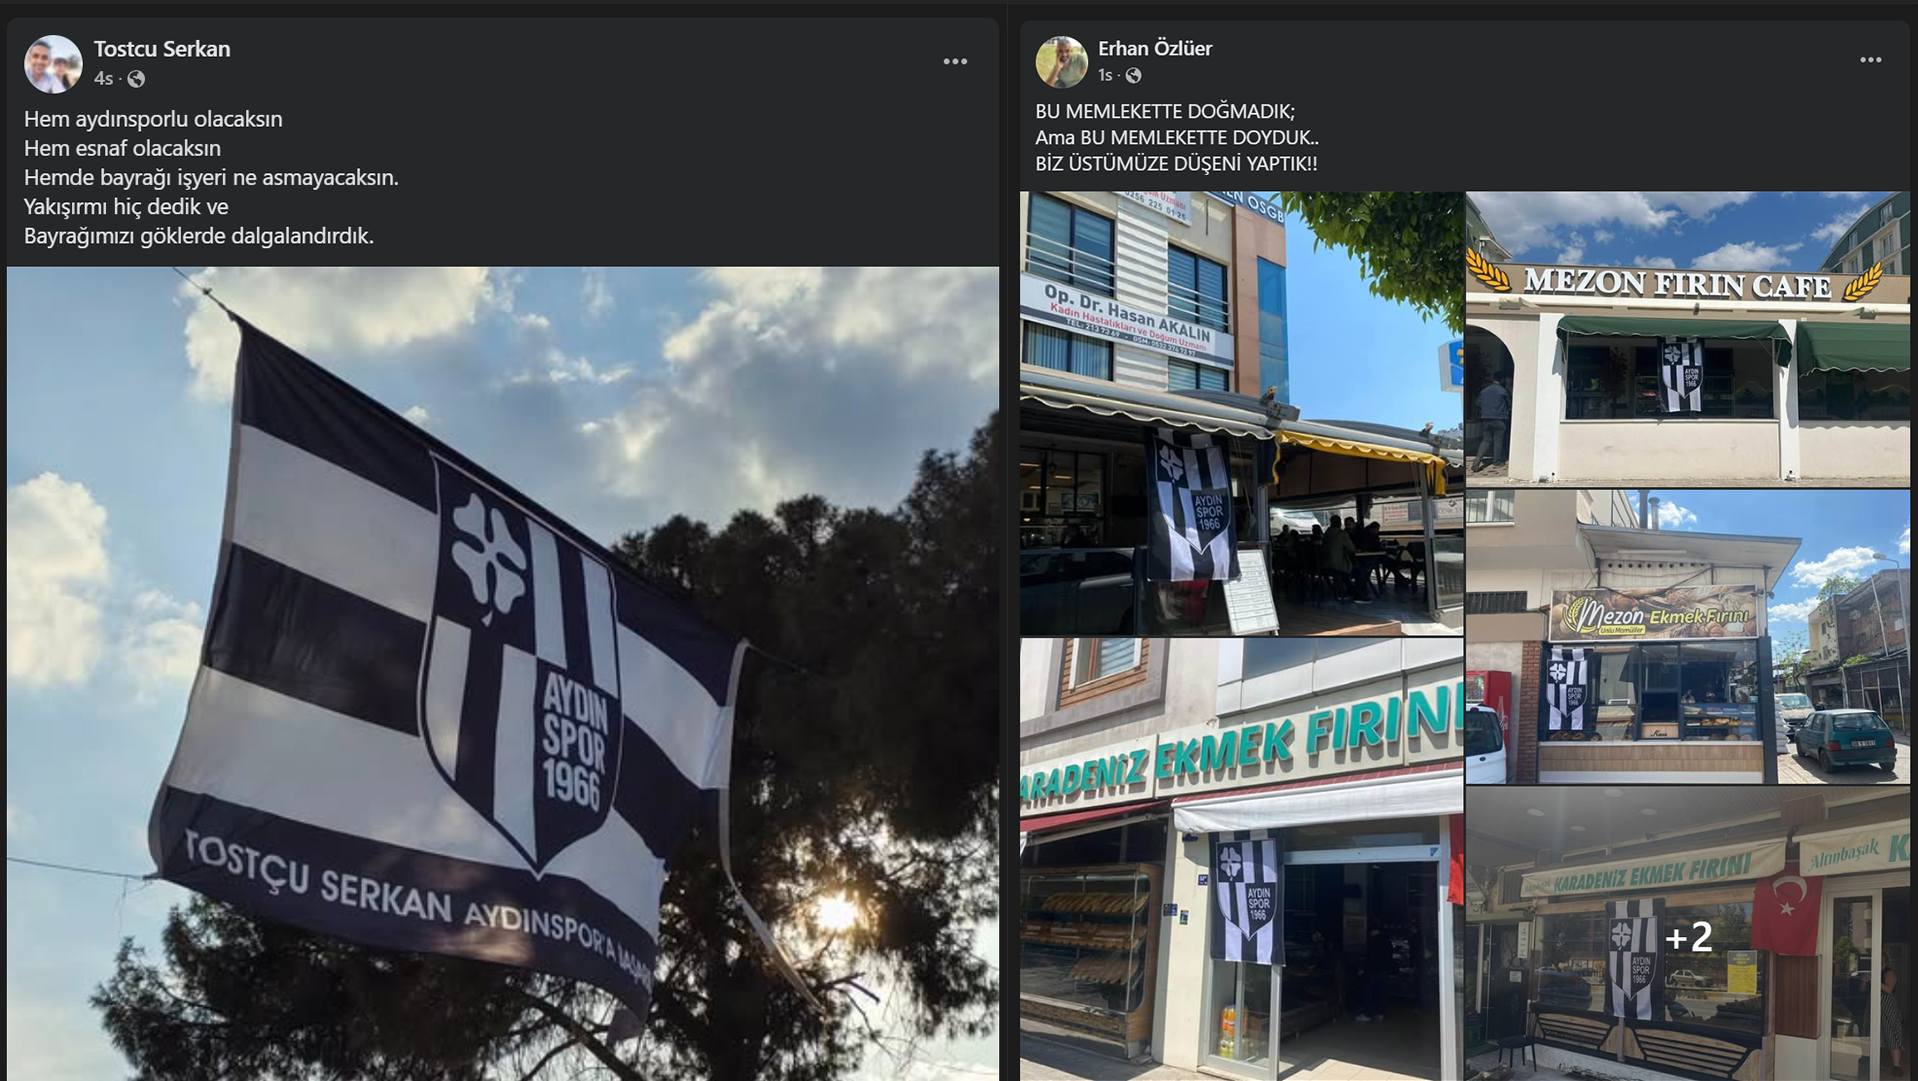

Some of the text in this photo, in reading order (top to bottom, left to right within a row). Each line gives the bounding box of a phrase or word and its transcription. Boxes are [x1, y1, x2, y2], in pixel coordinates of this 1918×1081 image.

[1148, 199, 1163, 211] 225
[1248, 196, 1284, 223] OSGB
[1524, 267, 1833, 300] MEZON FIRIN CAFE
[1044, 284, 1210, 343] Op. Dr. Hasan AKALIN
[1051, 302, 1080, 319] Kadın
[1082, 312, 1136, 335] Hastalıkları
[1137, 327, 1147, 338] ve
[1149, 329, 1177, 345] Doğum
[1195, 494, 1223, 507] AYDIN
[1196, 506, 1224, 519] SPOR
[1199, 518, 1221, 530] 1966
[1576, 598, 1750, 633] Mezon Ekmek Fırını
[543, 671, 609, 736] AYDIN
[542, 713, 606, 776] SPOR
[1155, 718, 1293, 779] EKMEK
[542, 759, 600, 812] 1966
[184, 828, 310, 896] TOSTÇU
[321, 869, 452, 925] SERKAN
[1630, 862, 1687, 886] EKMEK
[1689, 853, 1753, 880] FIRINI
[1248, 888, 1271, 898] AYDIN
[1248, 898, 1270, 909] SPOR
[1250, 909, 1267, 920] 1966
[1632, 957, 1651, 966] AYDIN
[1632, 966, 1650, 974] SPOR
[1633, 975, 1646, 984] 1966
